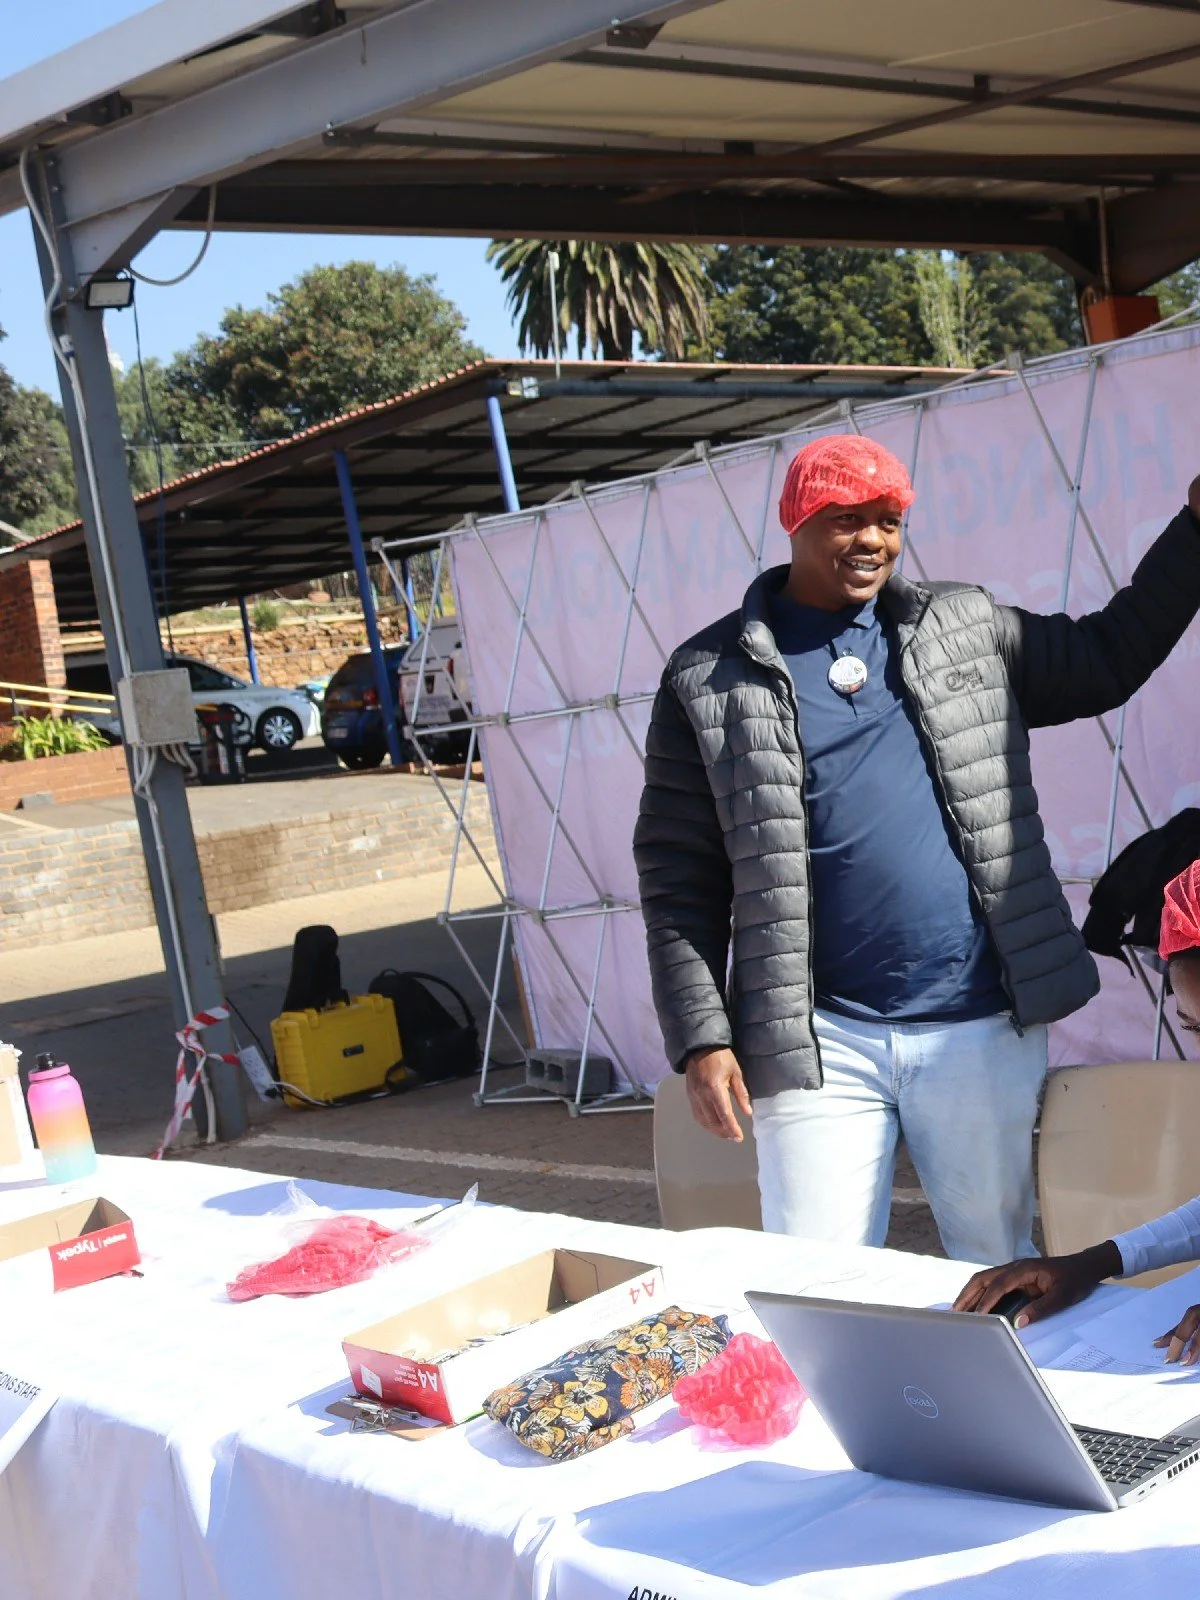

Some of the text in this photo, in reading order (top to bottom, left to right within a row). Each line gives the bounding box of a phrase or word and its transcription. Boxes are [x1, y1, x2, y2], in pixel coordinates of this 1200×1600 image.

[56, 1240, 99, 1261] Typek
[629, 1277, 655, 1304] A4
[13, 1380, 42, 1401] STAFF
[417, 1368, 438, 1392] A4
[908, 1397, 934, 1408] DELL
